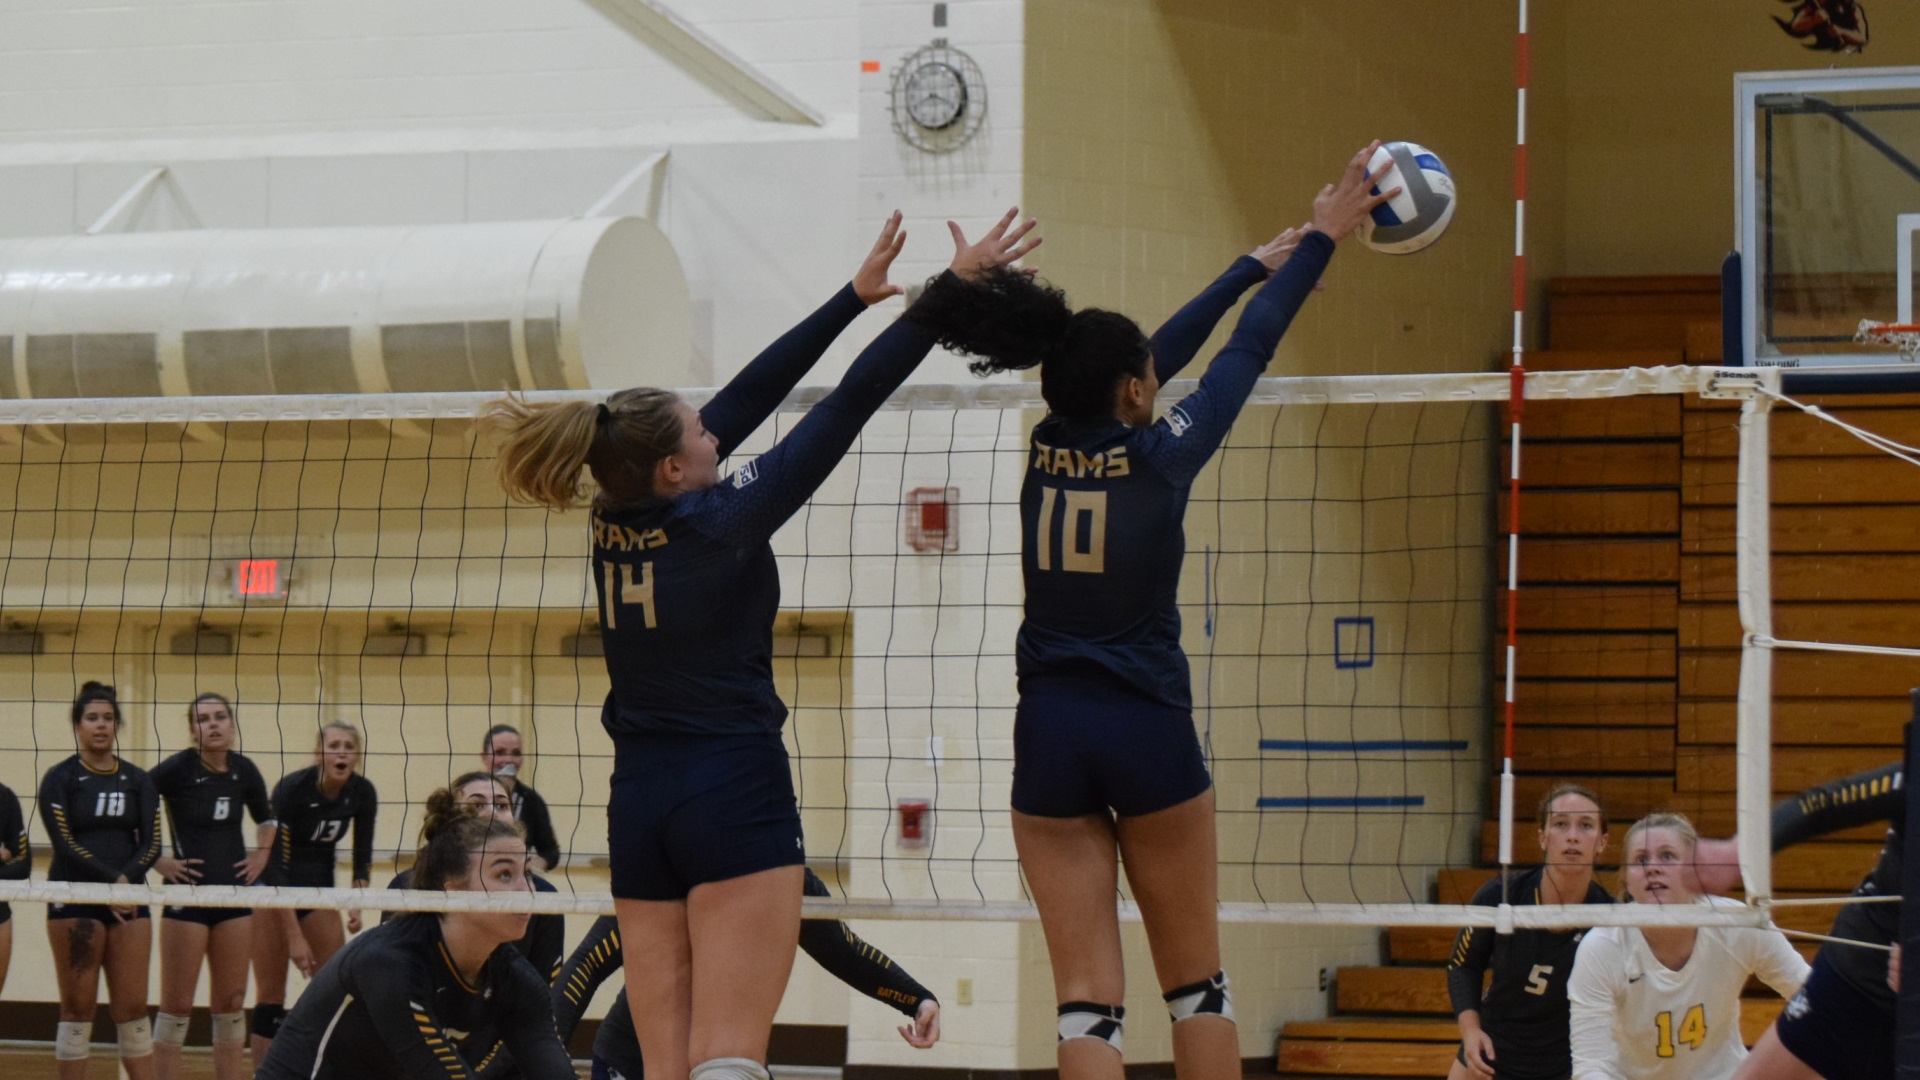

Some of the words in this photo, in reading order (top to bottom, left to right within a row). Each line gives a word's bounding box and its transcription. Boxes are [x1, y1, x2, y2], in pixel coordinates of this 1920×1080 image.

[1034, 440, 1130, 479] RAMS
[593, 517, 669, 552] RAMS
[1037, 486, 1107, 573] 10
[240, 560, 277, 594] EXIT
[602, 561, 657, 630] 14
[310, 820, 342, 842] 13
[1524, 964, 1554, 996] 5
[1655, 1003, 1707, 1058] 14
